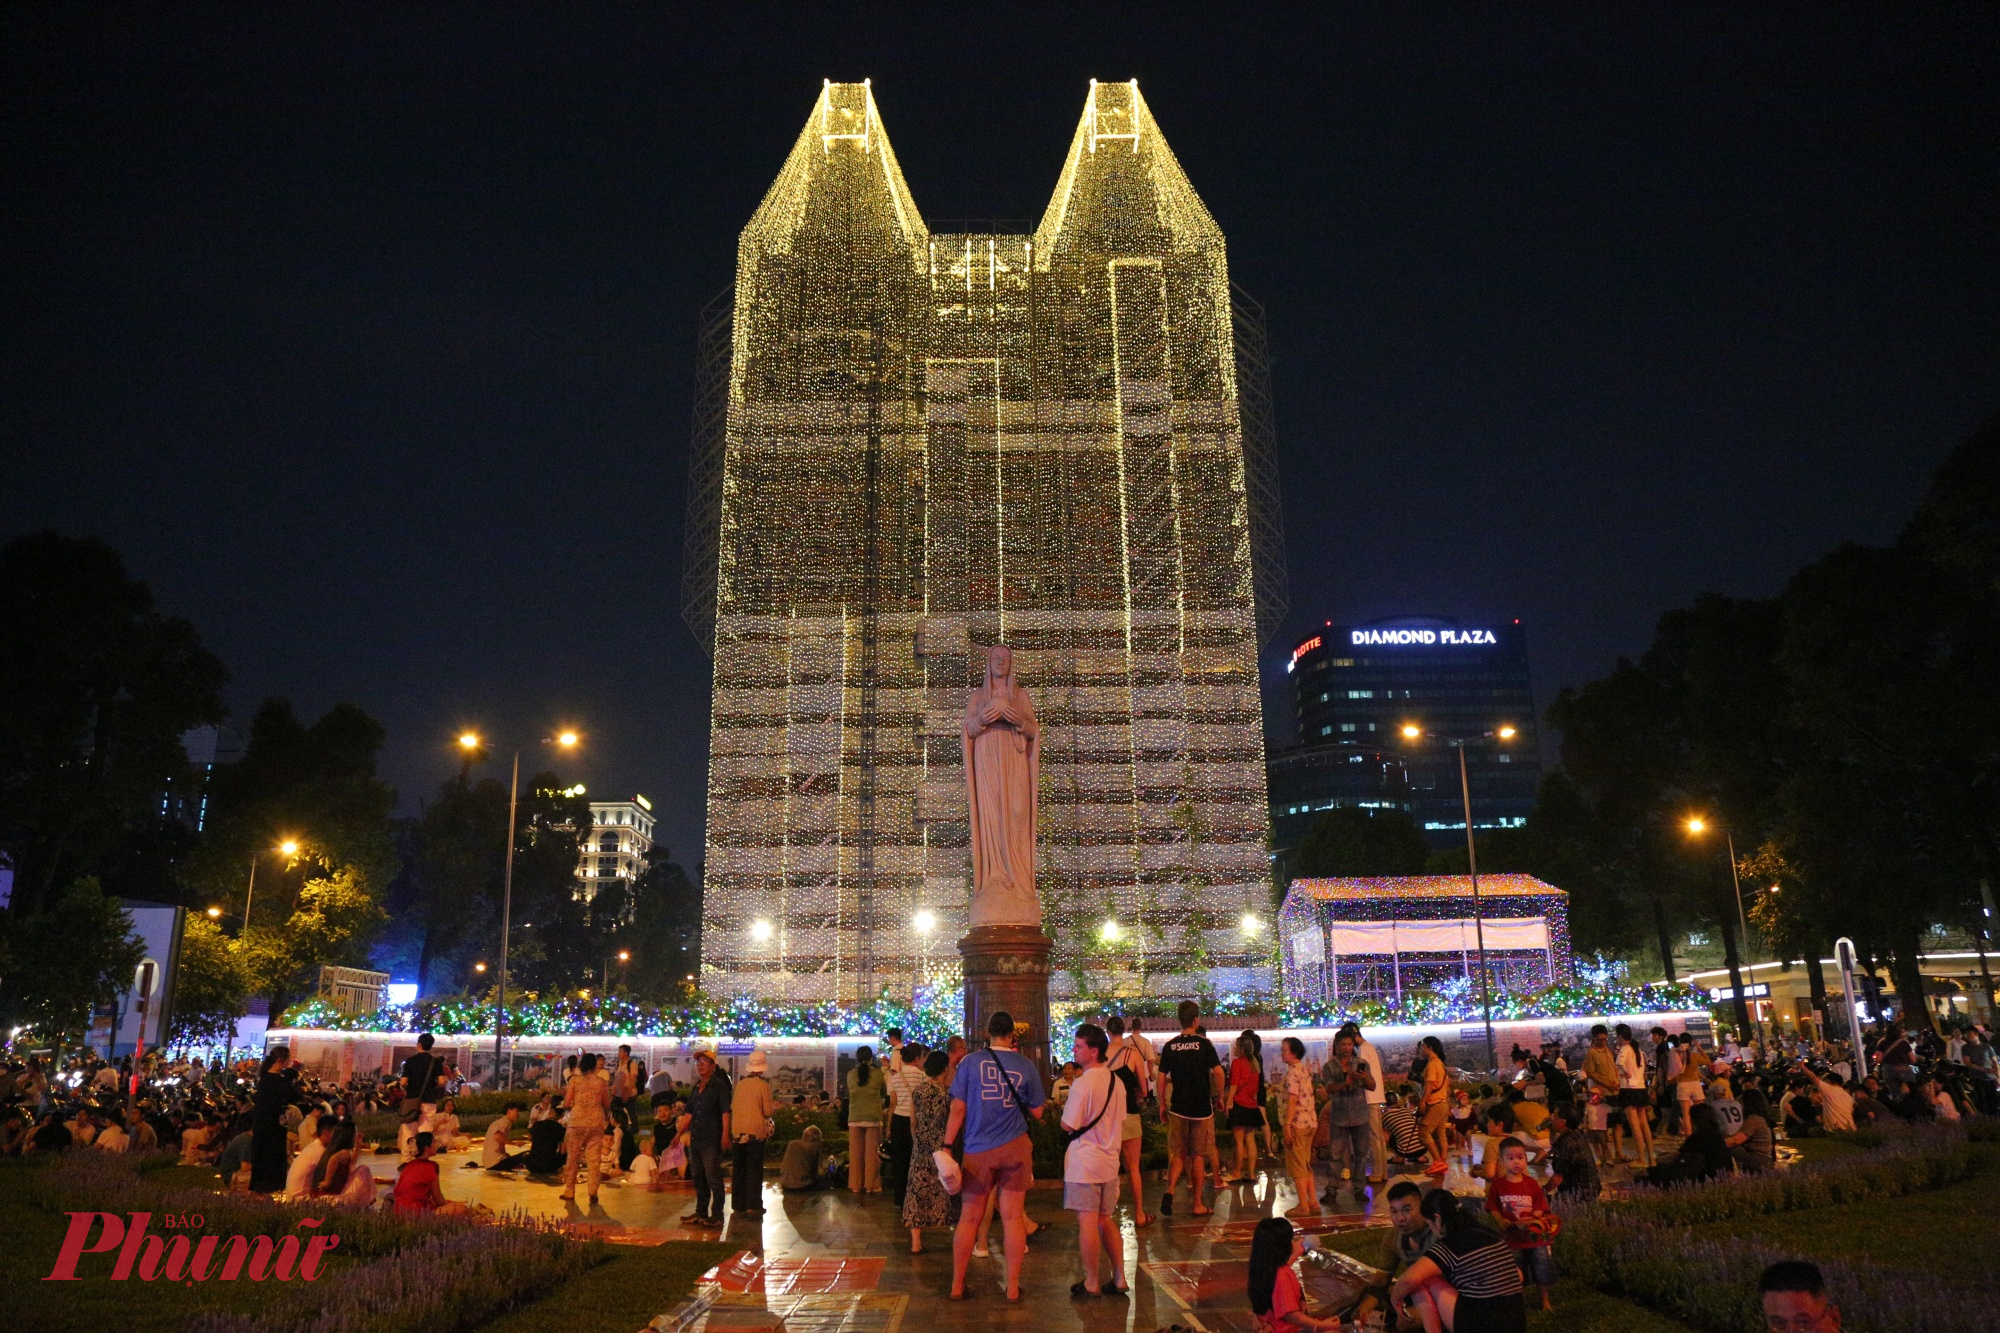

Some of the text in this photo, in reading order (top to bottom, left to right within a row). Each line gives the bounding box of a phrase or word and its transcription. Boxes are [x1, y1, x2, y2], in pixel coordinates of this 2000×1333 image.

[1352, 629, 1497, 645] DIAMOND PLAZA
[1297, 636, 1321, 657] LOTTE
[1177, 1042, 1200, 1050] SAGRES
[1720, 1106, 1742, 1123] 19
